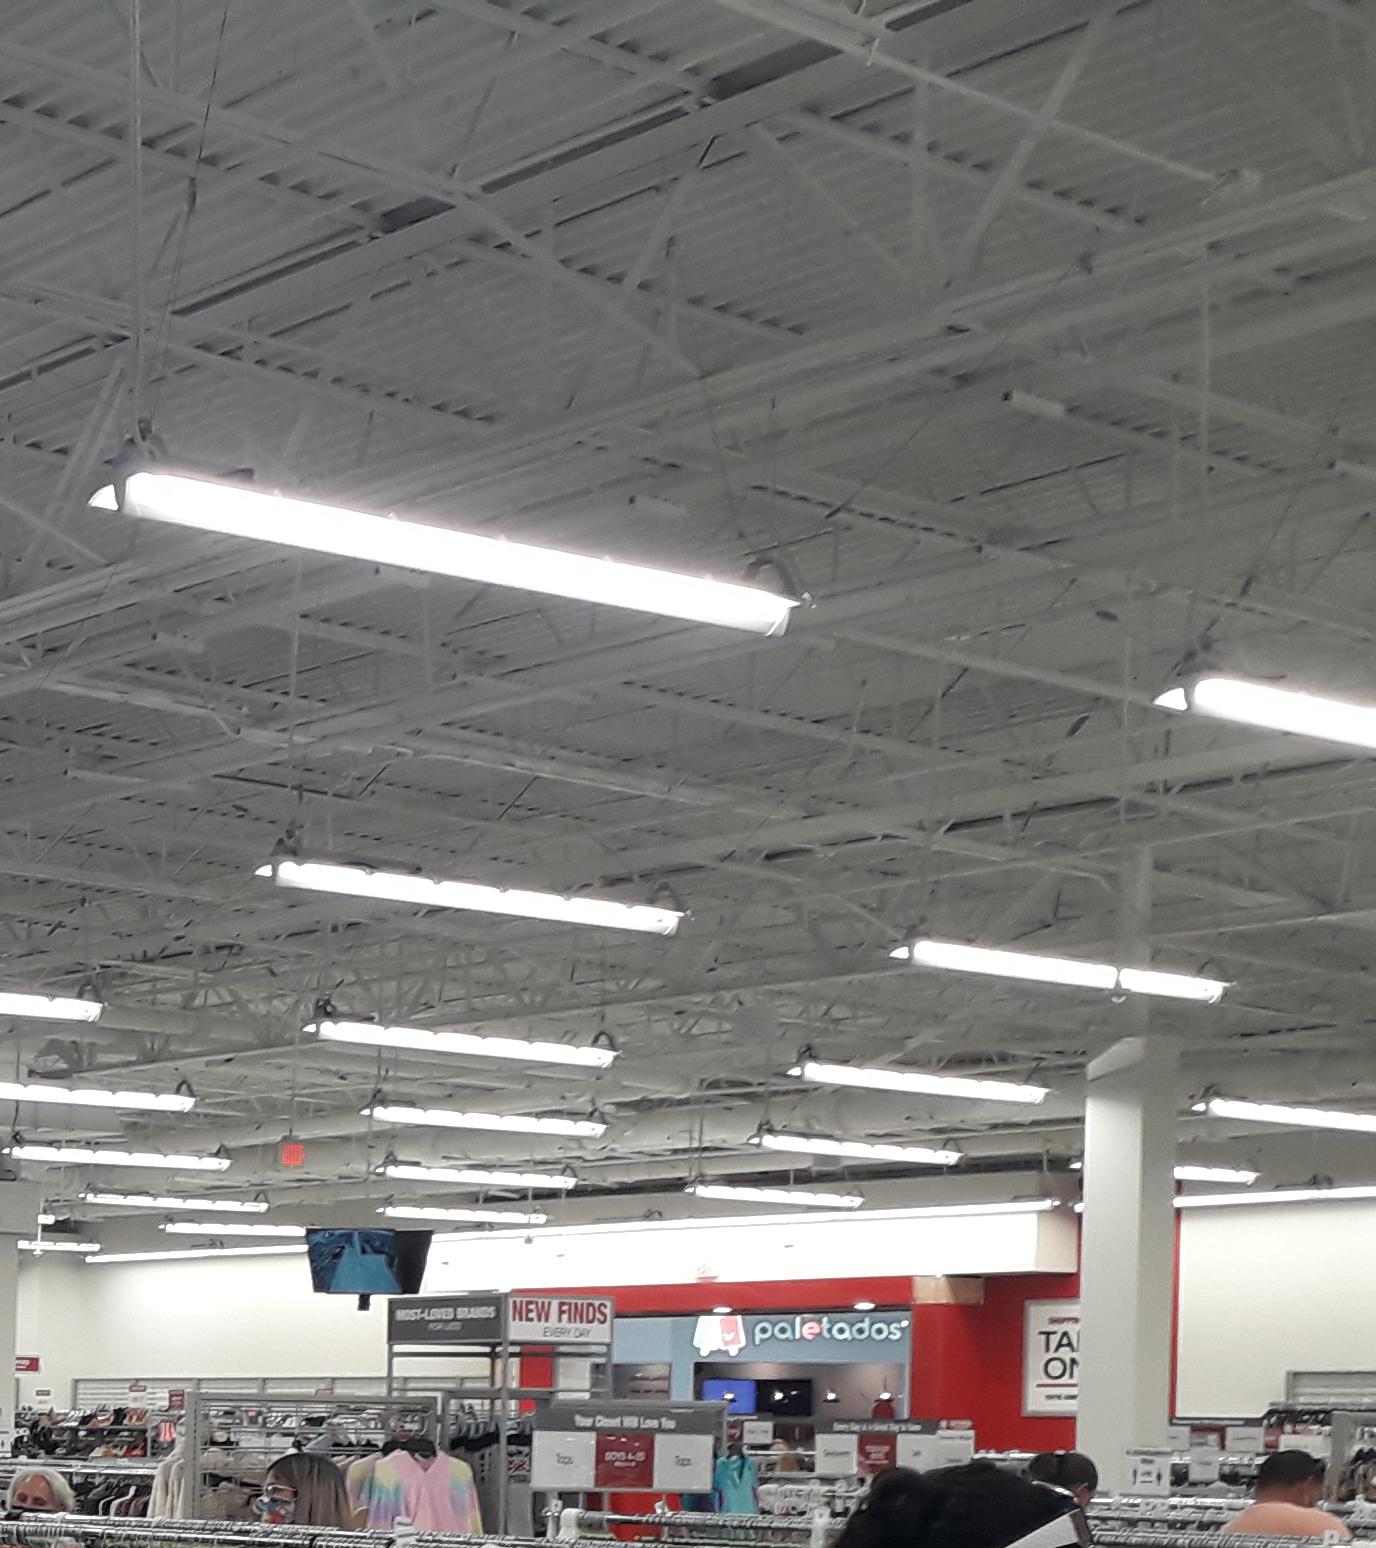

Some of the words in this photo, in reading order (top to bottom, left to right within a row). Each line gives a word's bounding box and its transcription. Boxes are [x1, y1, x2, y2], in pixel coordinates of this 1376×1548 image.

[511, 1300, 551, 1323] NEW
[557, 1302, 608, 1325] FINDS
[753, 1316, 903, 1346] paletados
